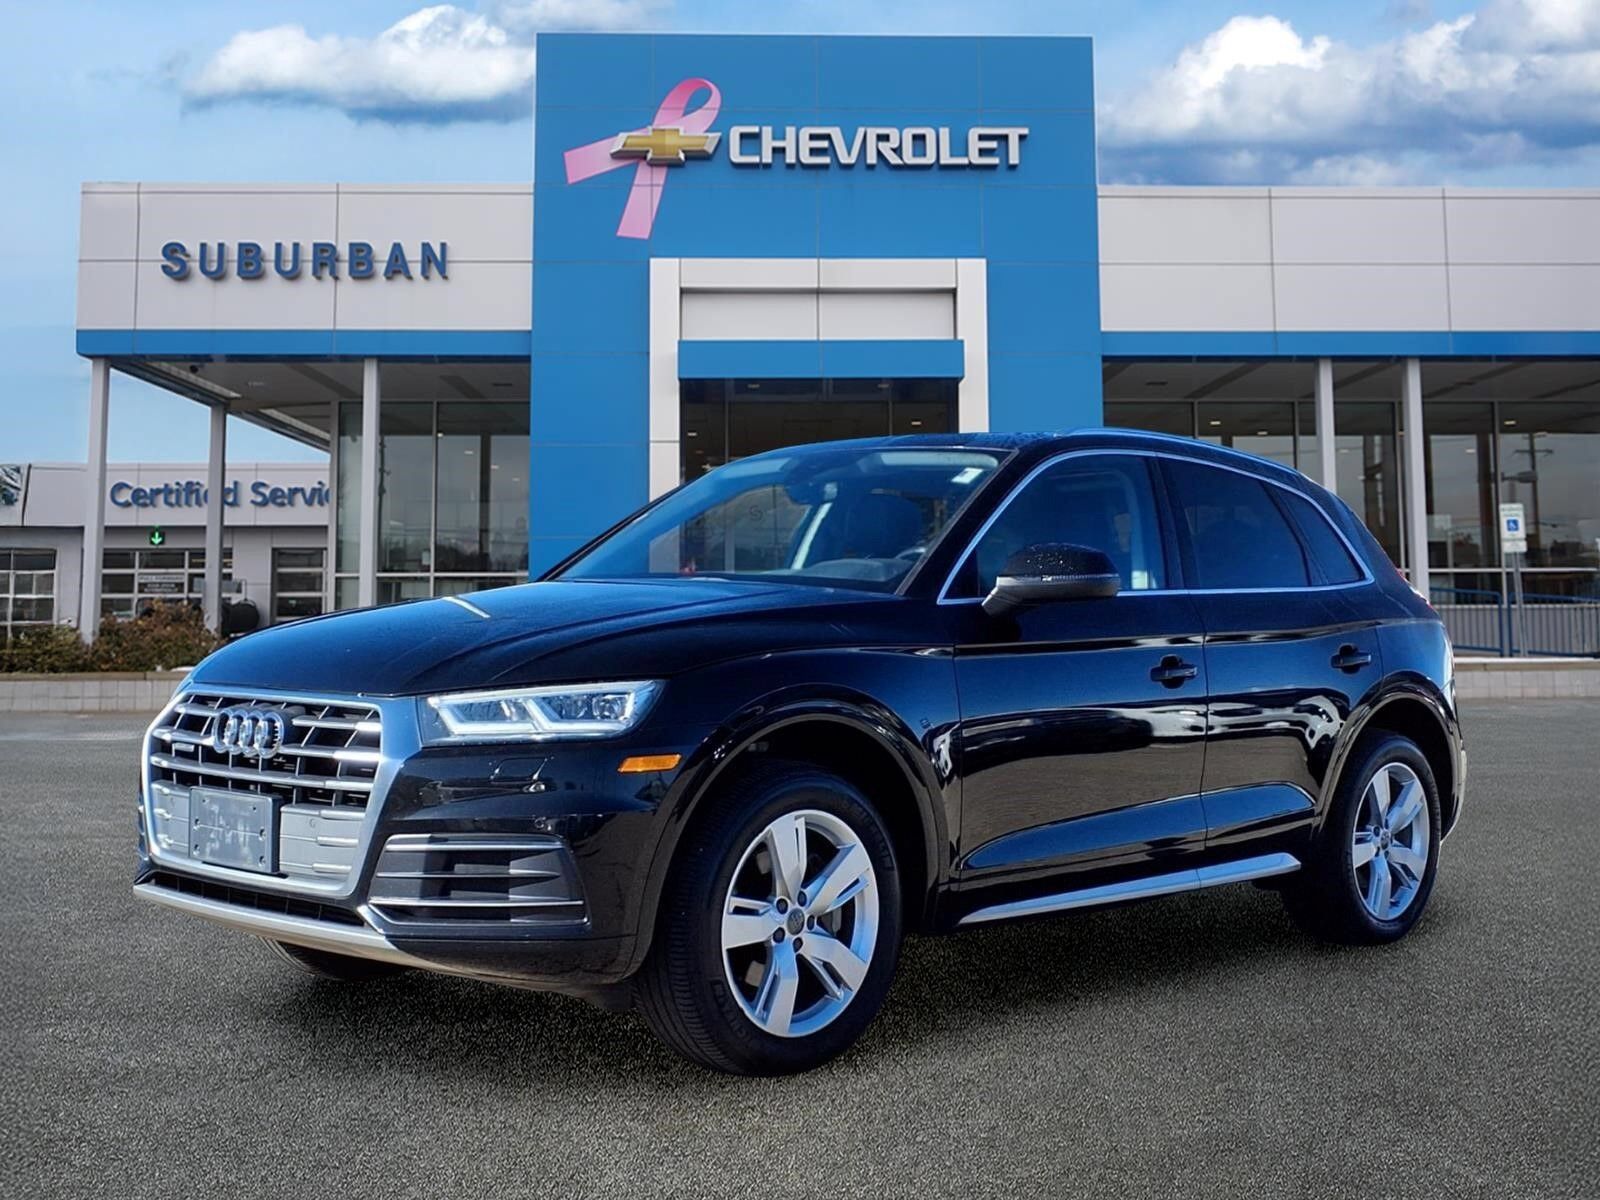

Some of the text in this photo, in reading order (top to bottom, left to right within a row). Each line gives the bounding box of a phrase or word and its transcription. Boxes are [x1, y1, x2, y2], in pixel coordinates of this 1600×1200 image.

[729, 125, 1029, 166] CHEVROLET
[161, 241, 449, 280] SUBURBAN
[110, 480, 240, 508] Certifid
